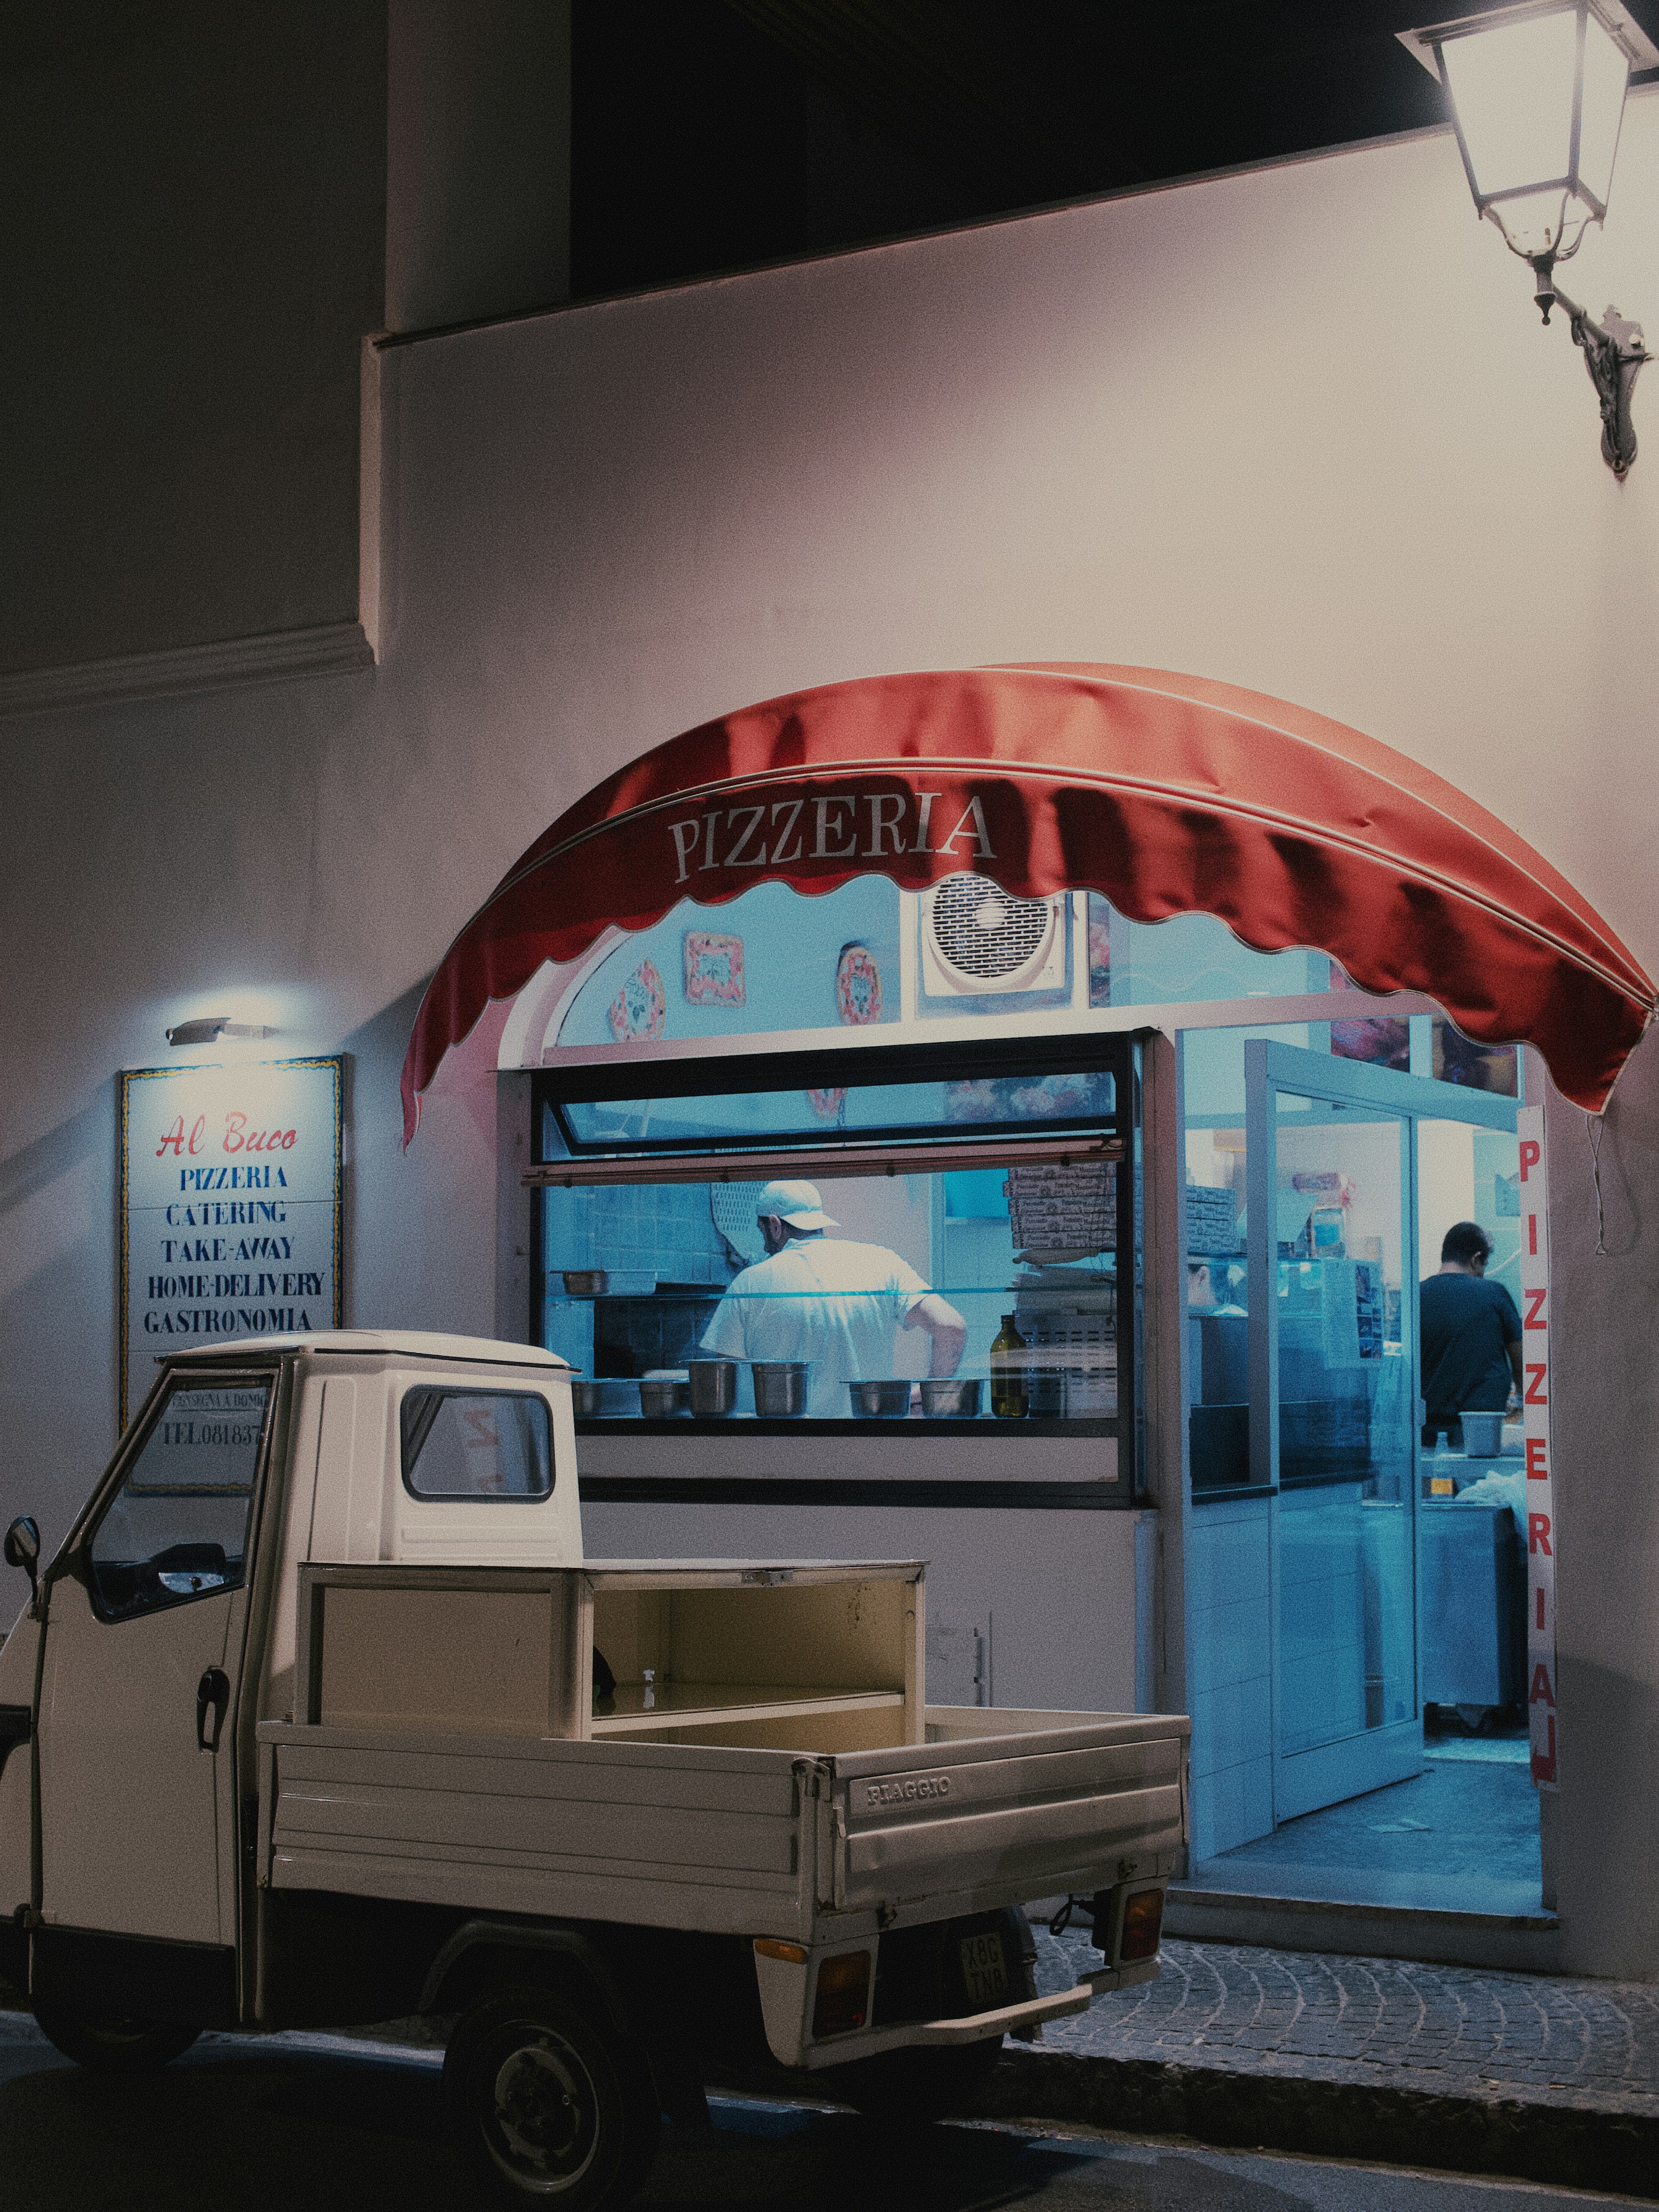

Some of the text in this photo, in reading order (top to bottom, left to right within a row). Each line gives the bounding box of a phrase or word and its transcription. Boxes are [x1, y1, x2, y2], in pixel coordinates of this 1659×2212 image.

[668, 792, 998, 885] PIZZERIA
[156, 1111, 298, 1157] Al Buco
[180, 1165, 288, 1191] PIZZERIA
[166, 1201, 287, 1226] CATERING
[161, 1237, 295, 1263] TAKE-AWAY
[149, 1272, 326, 1299] HOME-DELIVERY
[144, 1308, 313, 1334] GASTRONOMIA
[1519, 1140, 1556, 1708] PIZZERIA
[867, 1776, 951, 1806] PIAGGIO
